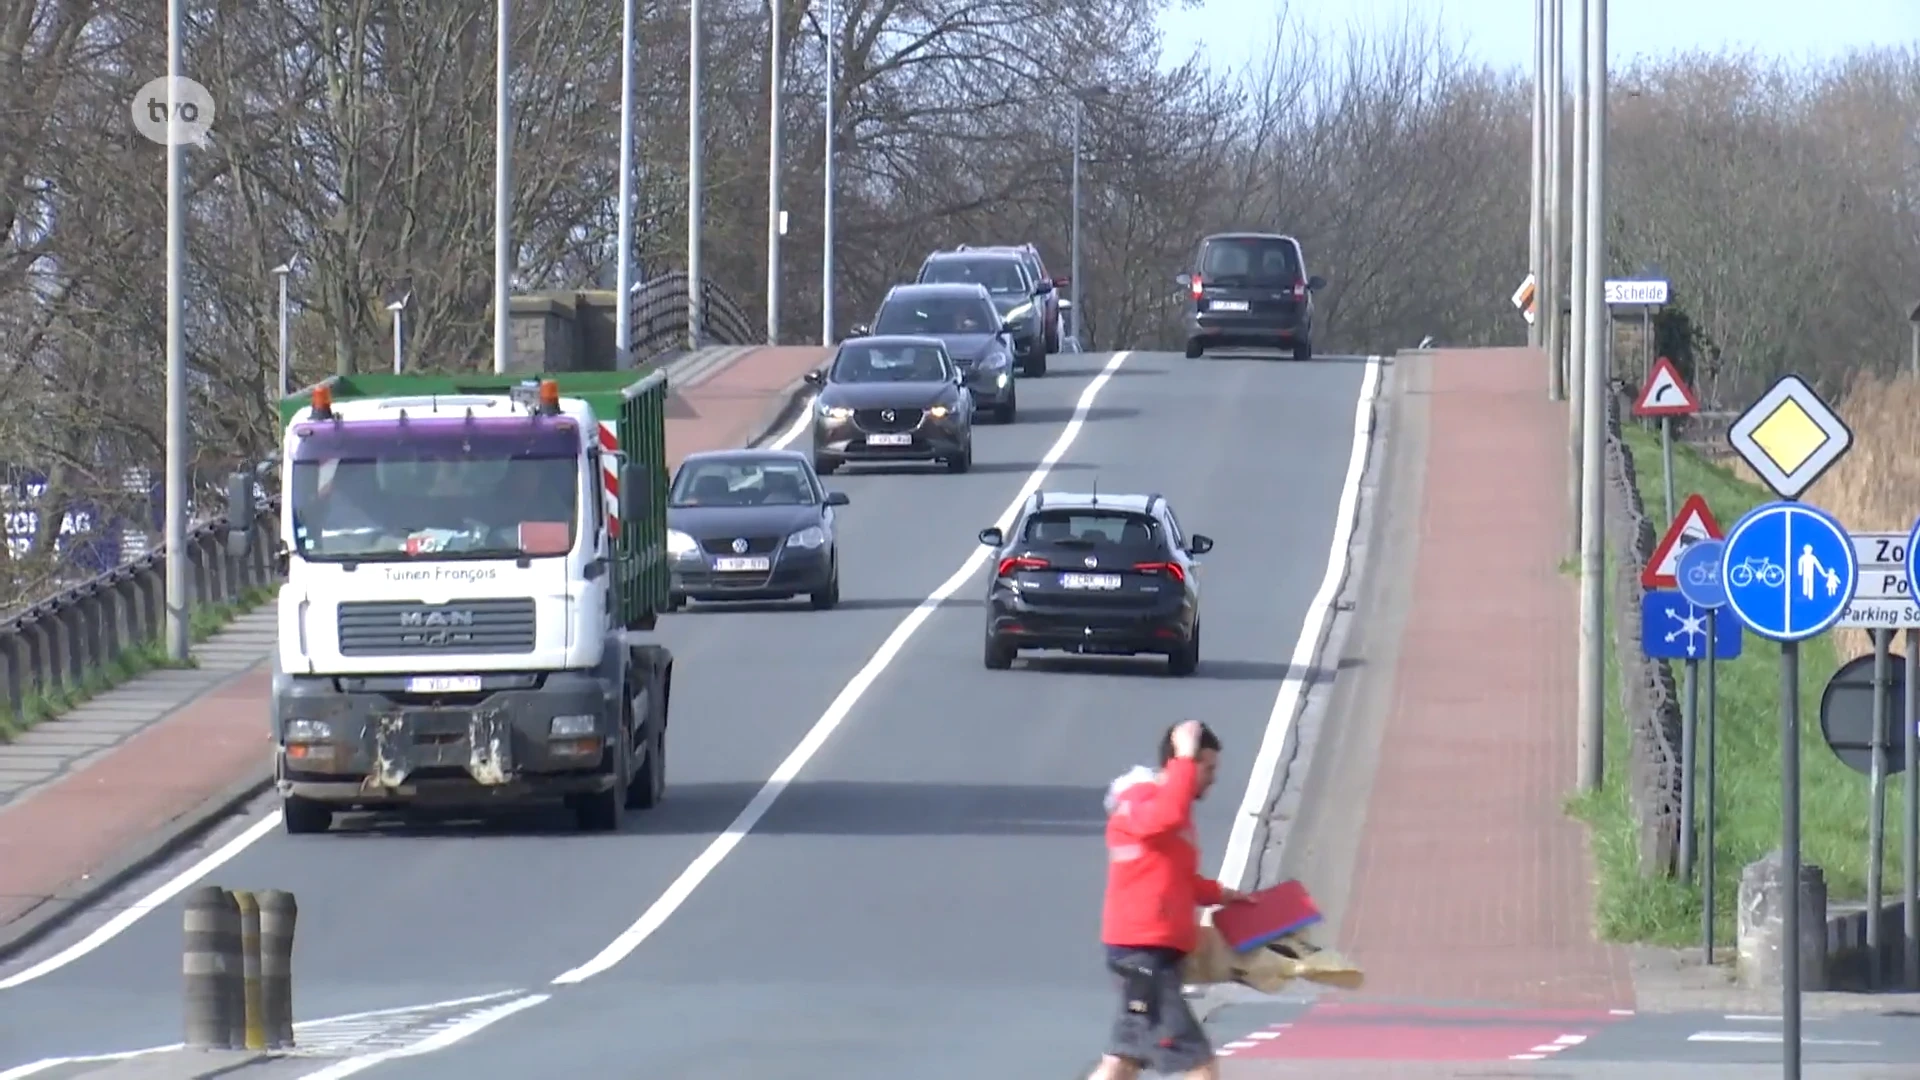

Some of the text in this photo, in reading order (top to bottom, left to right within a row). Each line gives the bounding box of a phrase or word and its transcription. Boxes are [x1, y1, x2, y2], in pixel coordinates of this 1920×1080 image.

[1615, 284, 1664, 301] Schelde
[384, 566, 497, 583] Tuinen François
[401, 611, 473, 627] MAN
[1842, 606, 1899, 625] Parking
